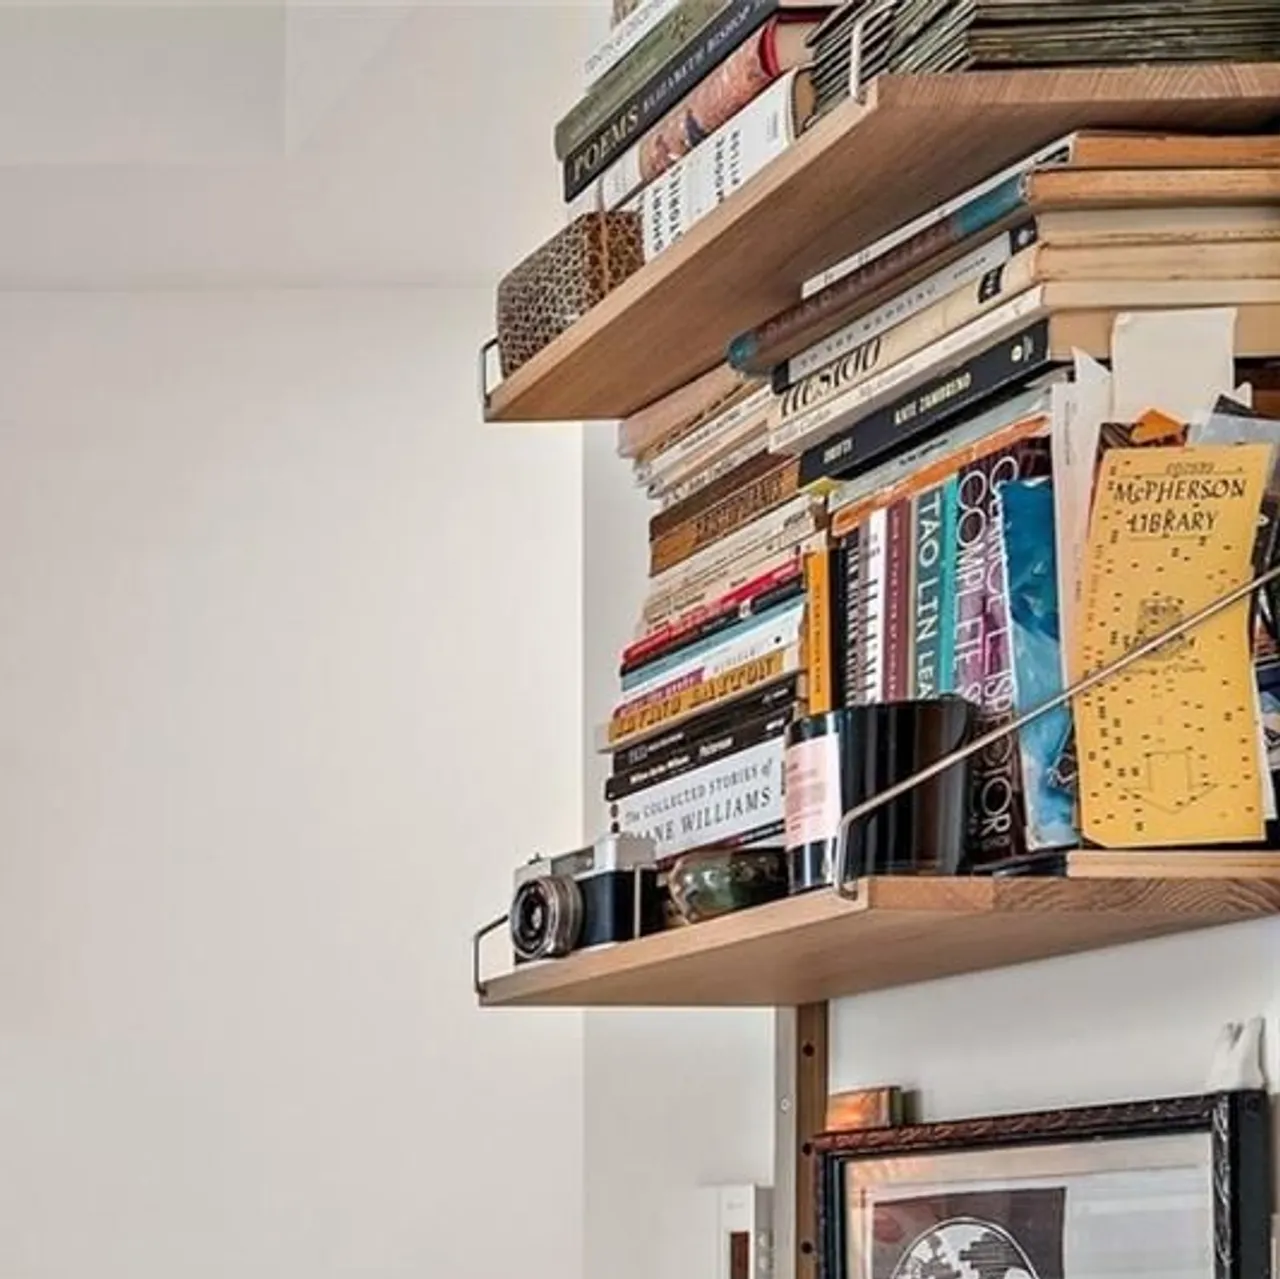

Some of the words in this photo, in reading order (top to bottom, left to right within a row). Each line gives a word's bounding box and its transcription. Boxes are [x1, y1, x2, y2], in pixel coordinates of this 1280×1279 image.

[570, 106, 640, 183] POEMS
[651, 187, 664, 252] SHORT
[1114, 478, 1247, 505] McPHERSON
[1126, 508, 1217, 534] LIBRARY
[917, 491, 941, 568] TAO
[953, 470, 988, 672] COMPLETE
[915, 578, 939, 643] LIN
[917, 650, 936, 700] LEA
[634, 823, 674, 842] ANE
[681, 786, 772, 834] WILLIAMS
[644, 782, 706, 818] COLLECTED
[708, 765, 759, 795] STORIES
